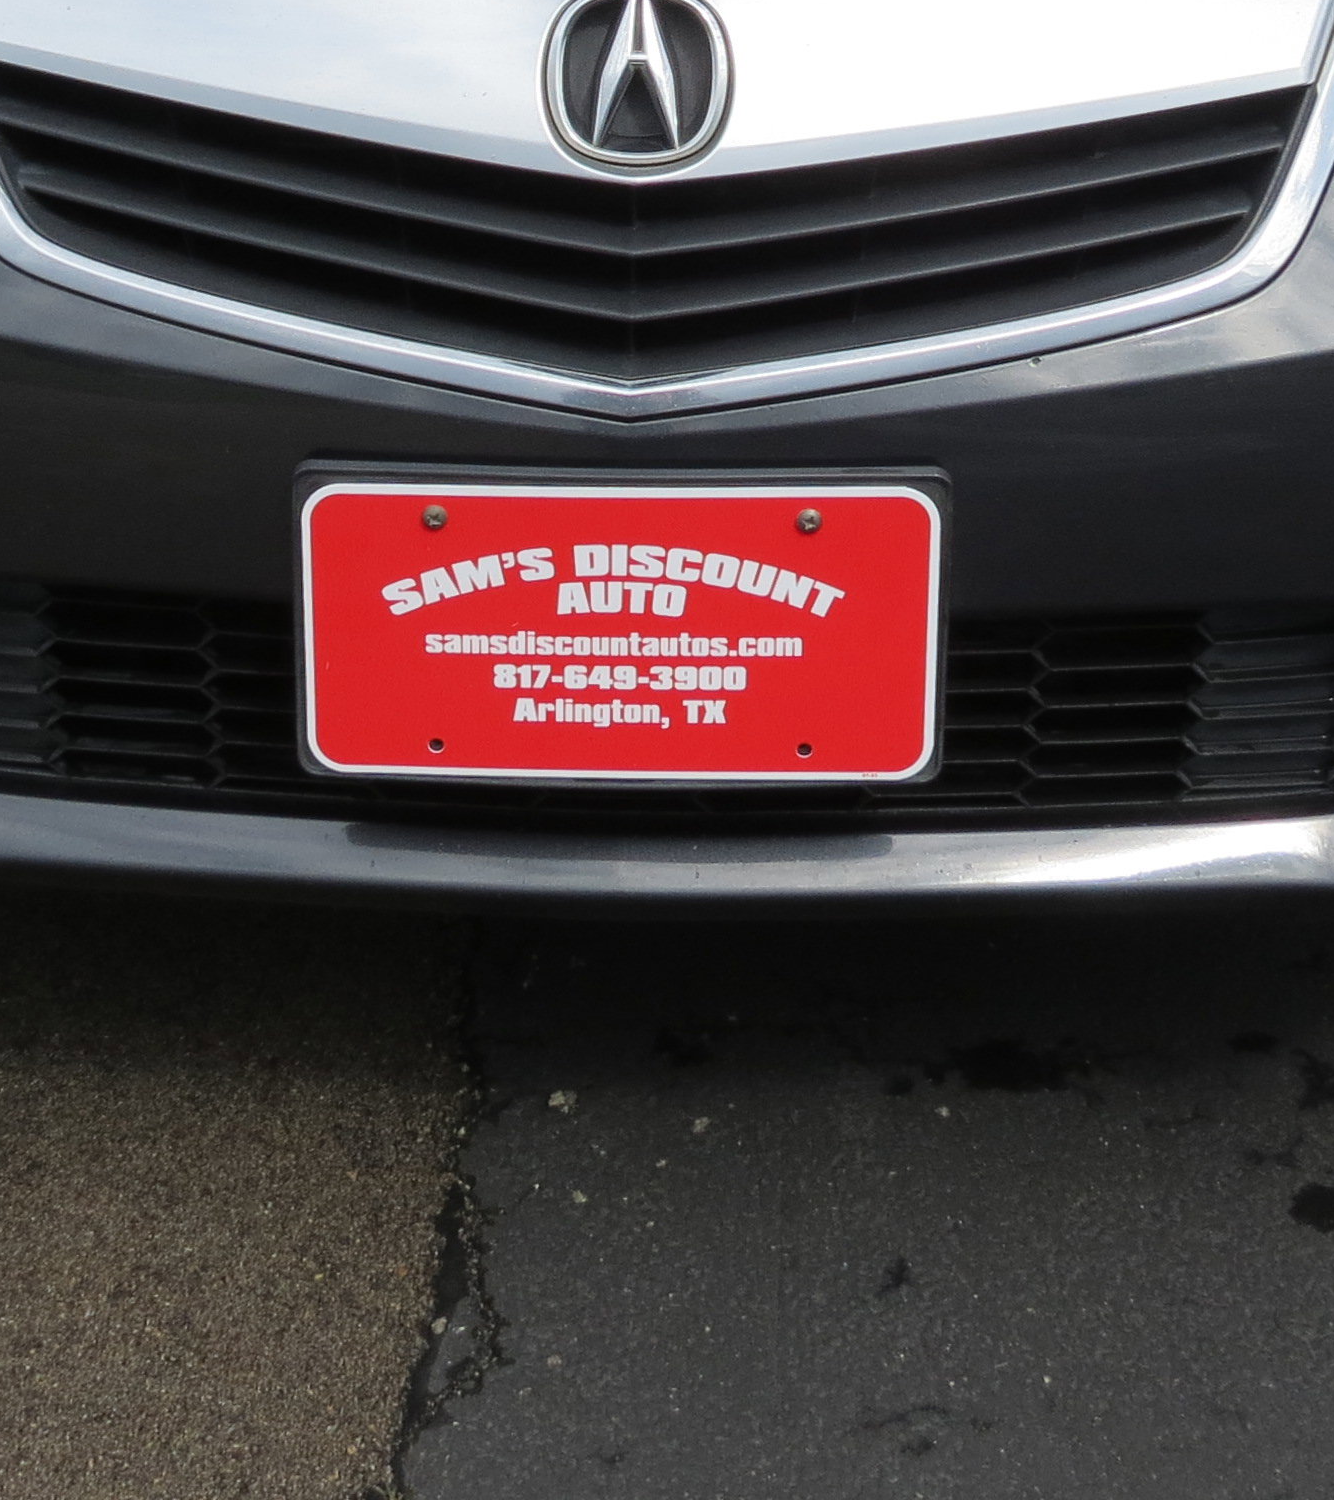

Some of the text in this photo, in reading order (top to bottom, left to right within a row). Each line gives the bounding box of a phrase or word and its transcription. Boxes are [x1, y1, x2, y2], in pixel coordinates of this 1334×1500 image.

[381, 544, 846, 618] SAM'S DISCOUNT
[556, 581, 687, 618] AUTO
[425, 630, 803, 657] samsdiscountautos.com
[493, 663, 747, 691] 817-649-3900
[513, 697, 727, 729] Arlington, TX
